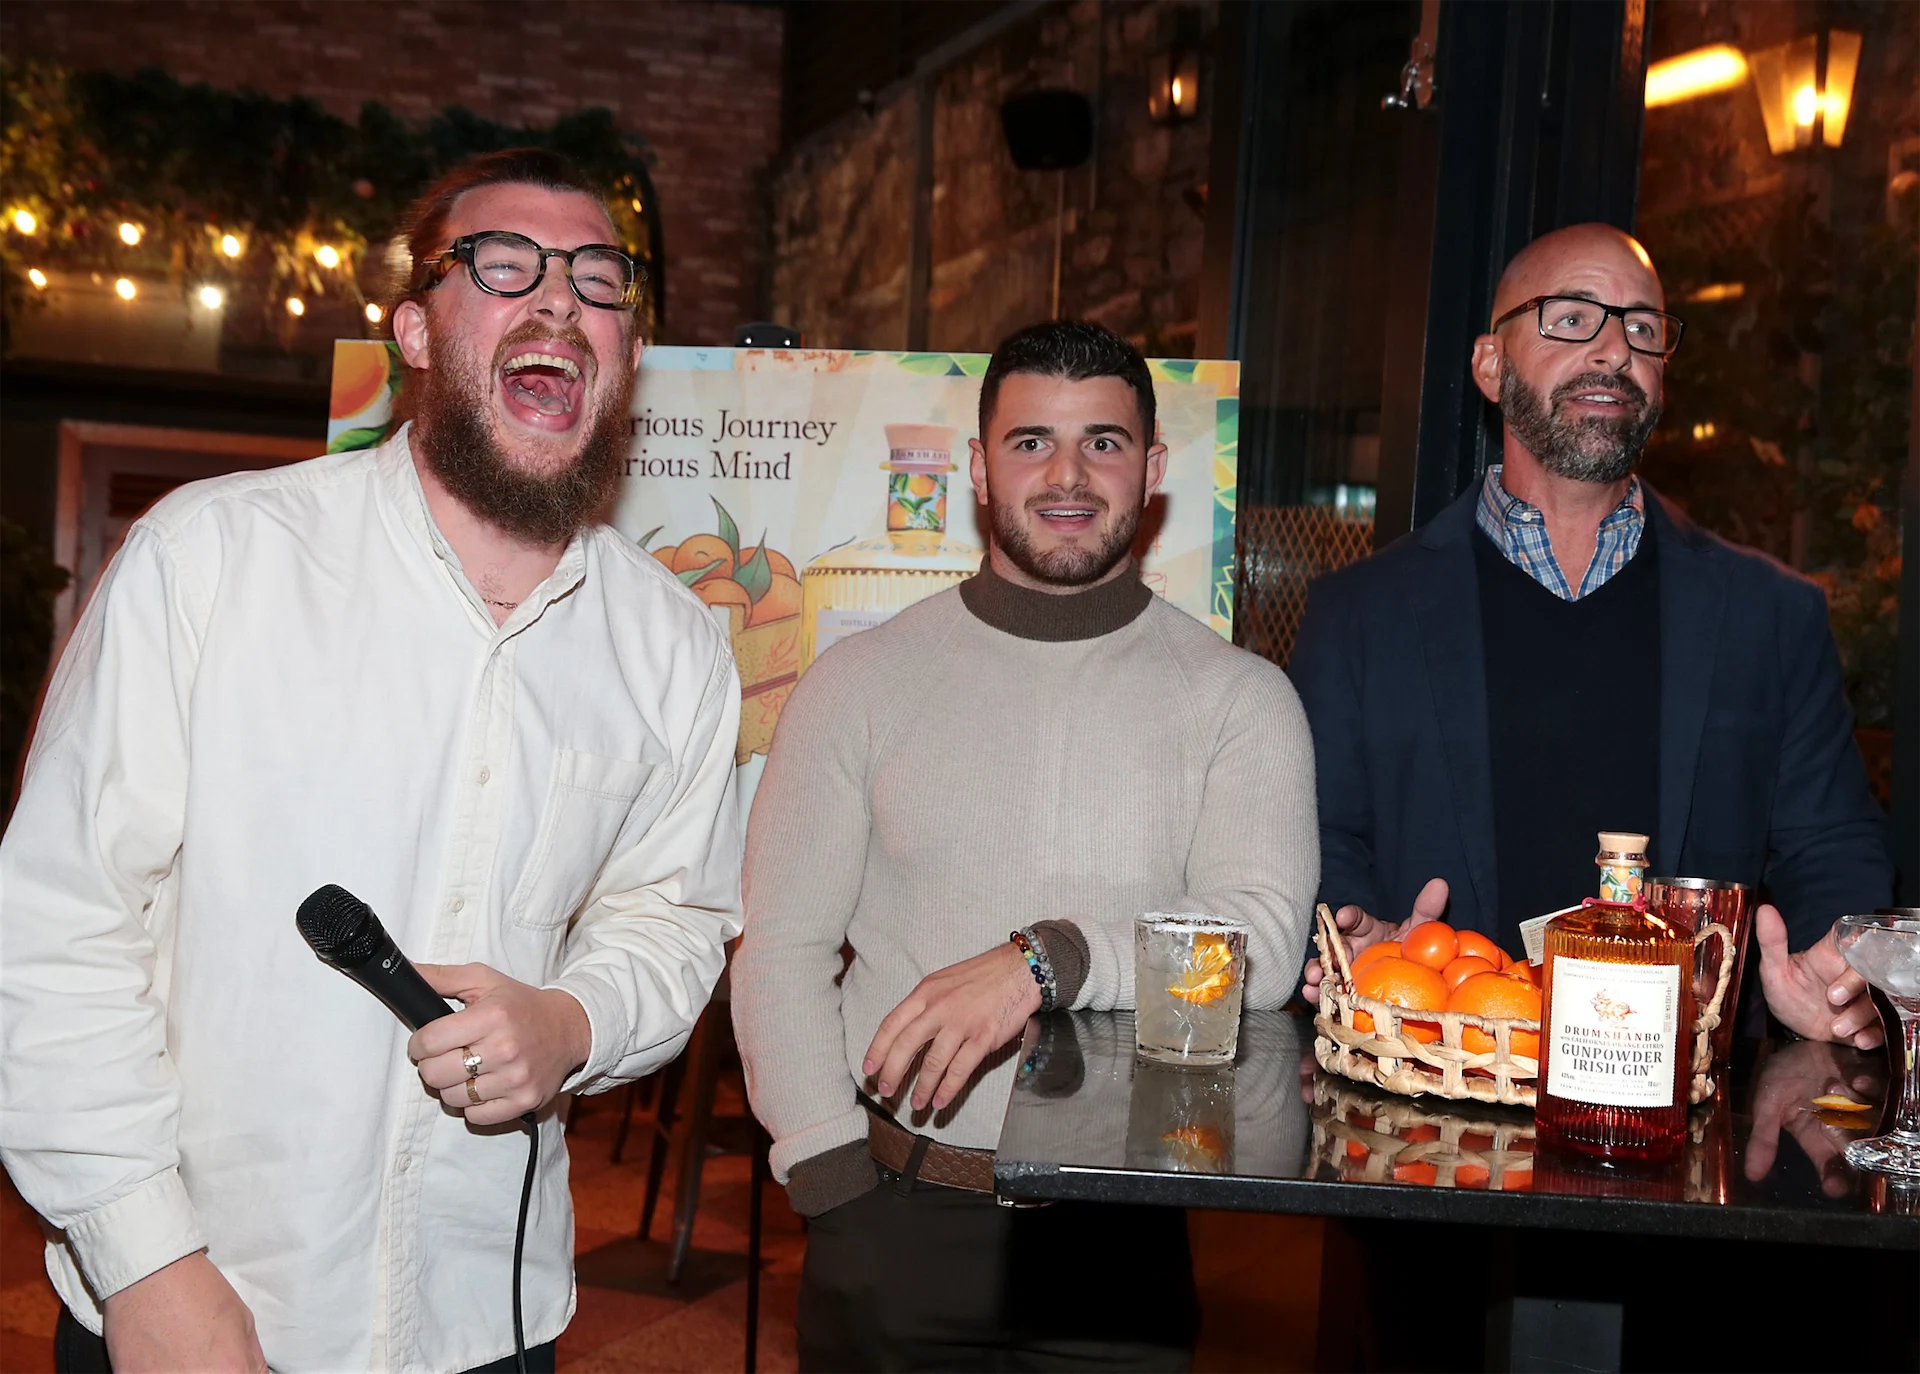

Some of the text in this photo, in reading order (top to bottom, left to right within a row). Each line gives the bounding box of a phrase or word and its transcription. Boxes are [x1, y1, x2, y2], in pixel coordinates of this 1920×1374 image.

[630, 408, 838, 446] rious Journey
[709, 450, 792, 480] Mind
[1564, 1025, 1661, 1042] DRUMSHANBO
[1561, 1043, 1663, 1064] GUNPOWDER
[1573, 1058, 1616, 1075] IRISH
